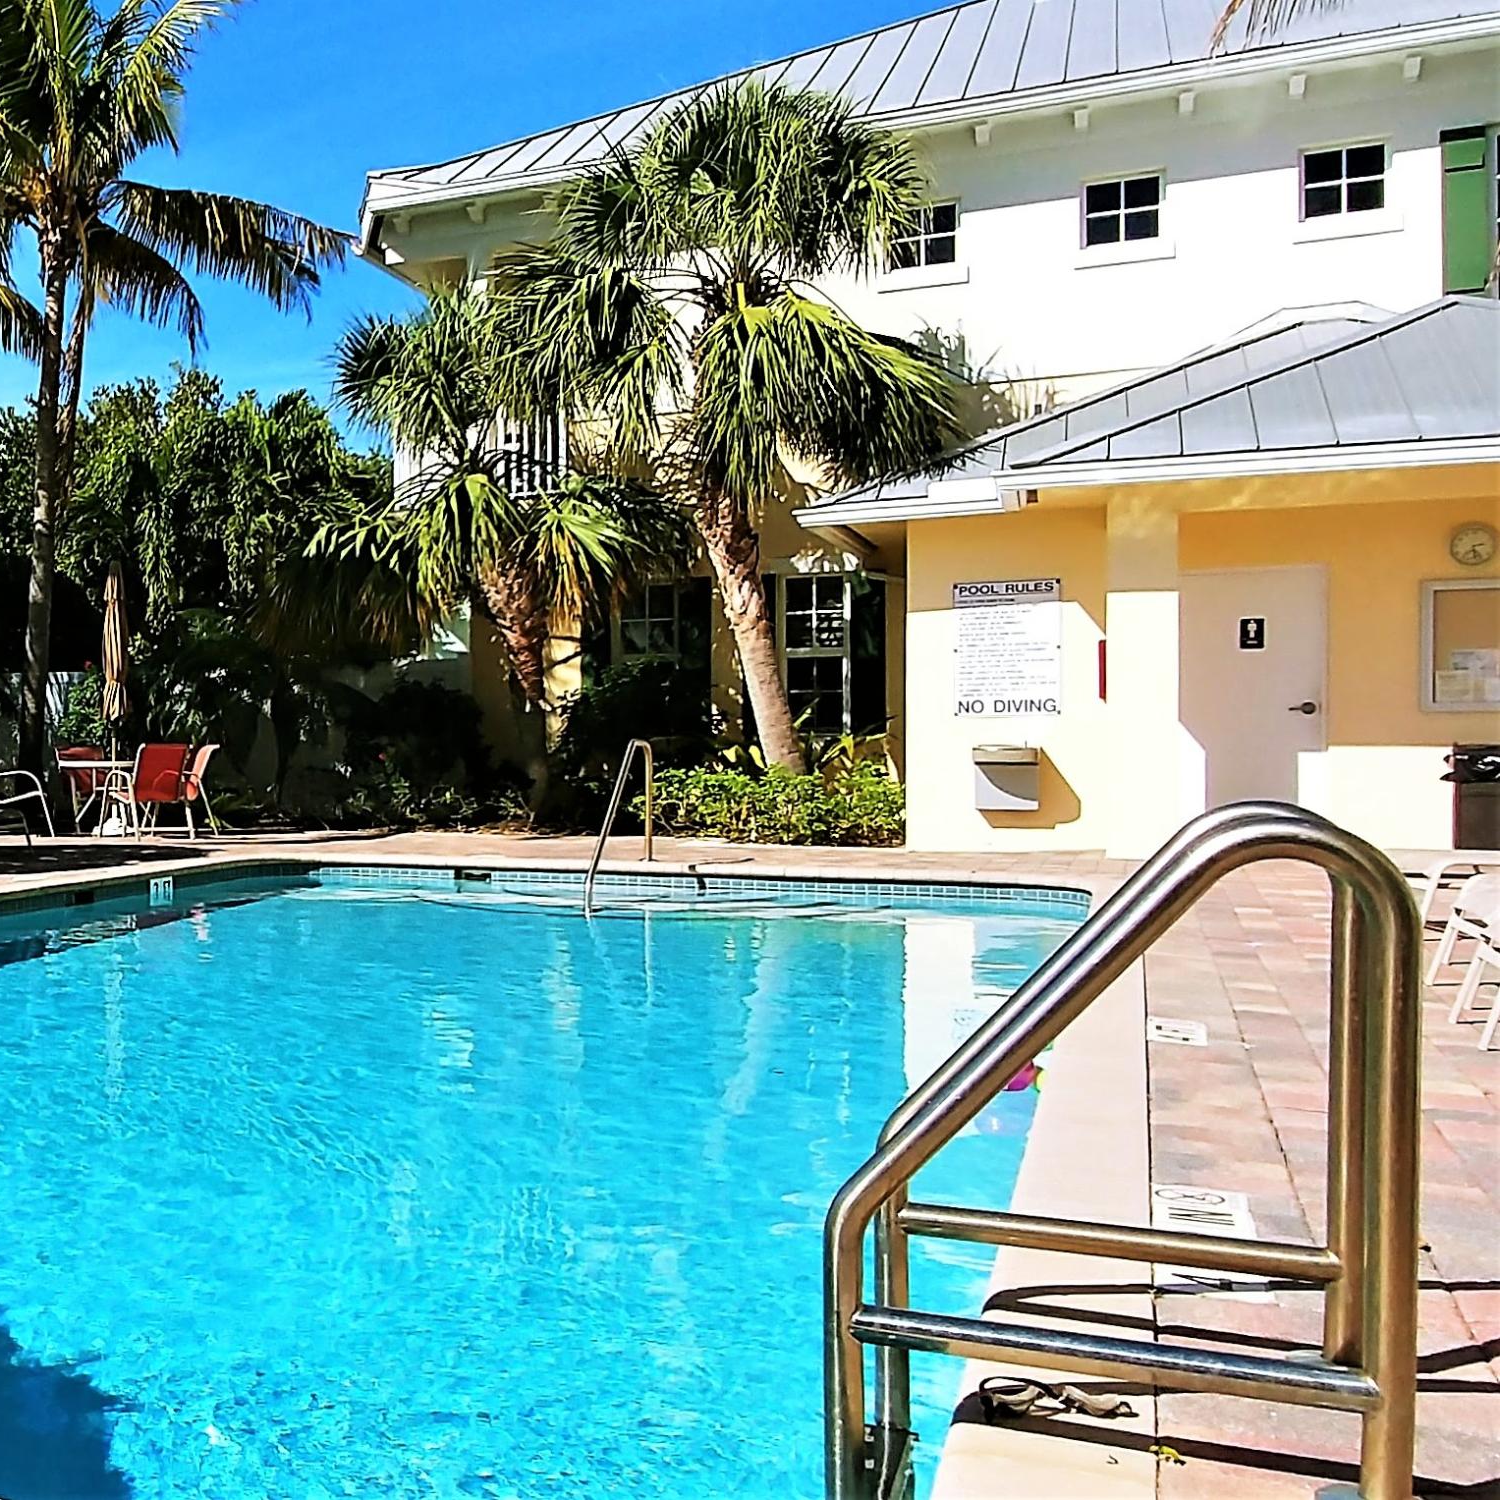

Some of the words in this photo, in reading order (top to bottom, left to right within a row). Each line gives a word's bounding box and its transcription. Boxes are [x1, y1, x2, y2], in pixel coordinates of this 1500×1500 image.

[959, 585, 999, 595] POOL
[1005, 582, 1054, 593] RULES
[958, 700, 985, 713] NO
[994, 698, 1057, 712] DIVING
